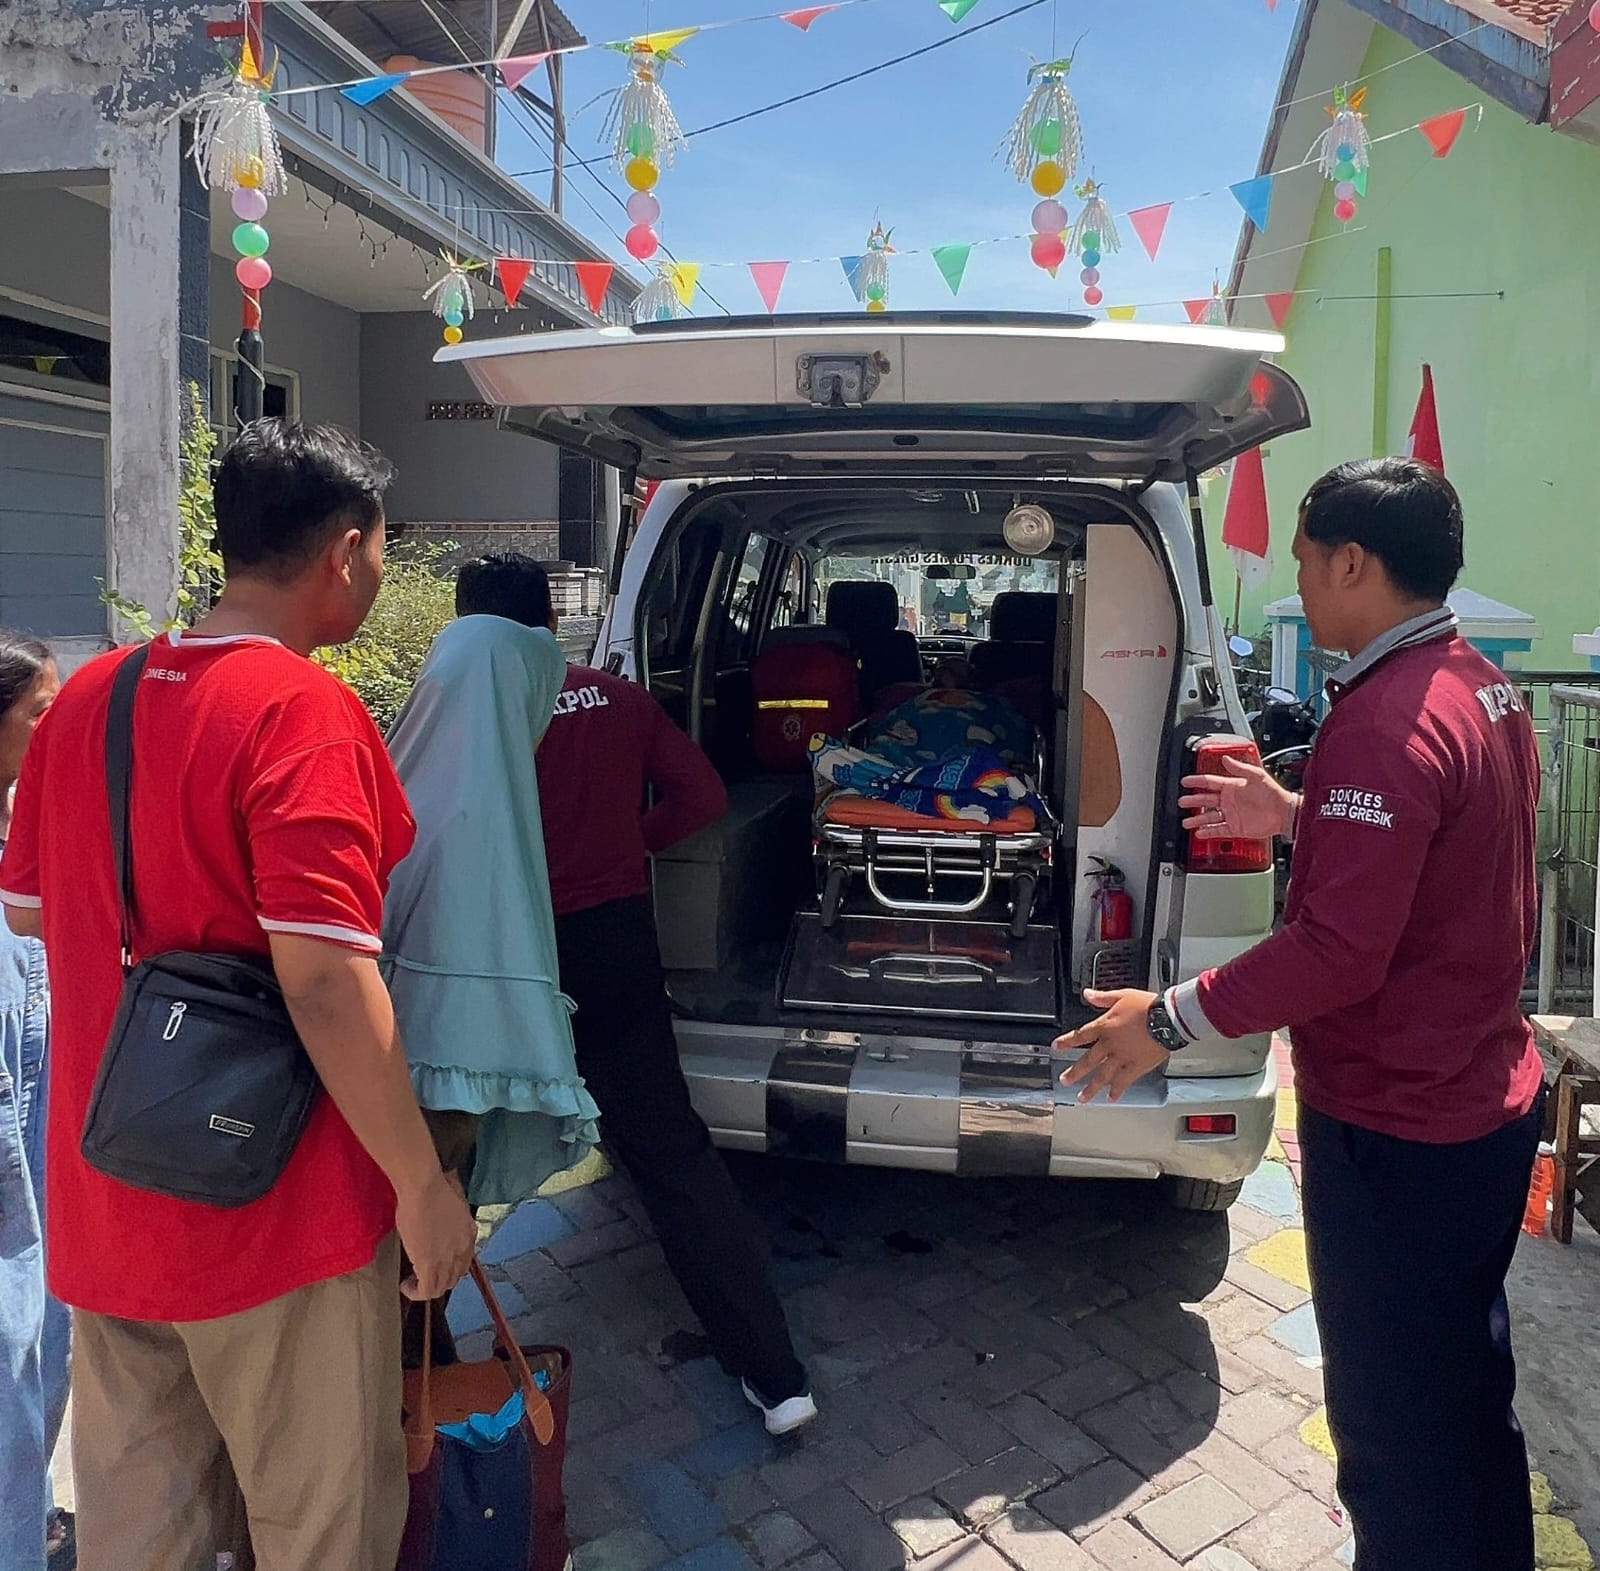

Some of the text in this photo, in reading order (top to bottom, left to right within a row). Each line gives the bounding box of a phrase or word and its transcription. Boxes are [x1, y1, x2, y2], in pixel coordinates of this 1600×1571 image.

[553, 686, 609, 715] KPOL
[1329, 788, 1383, 809] DOKKES
[1348, 805, 1394, 829] GRESIK
